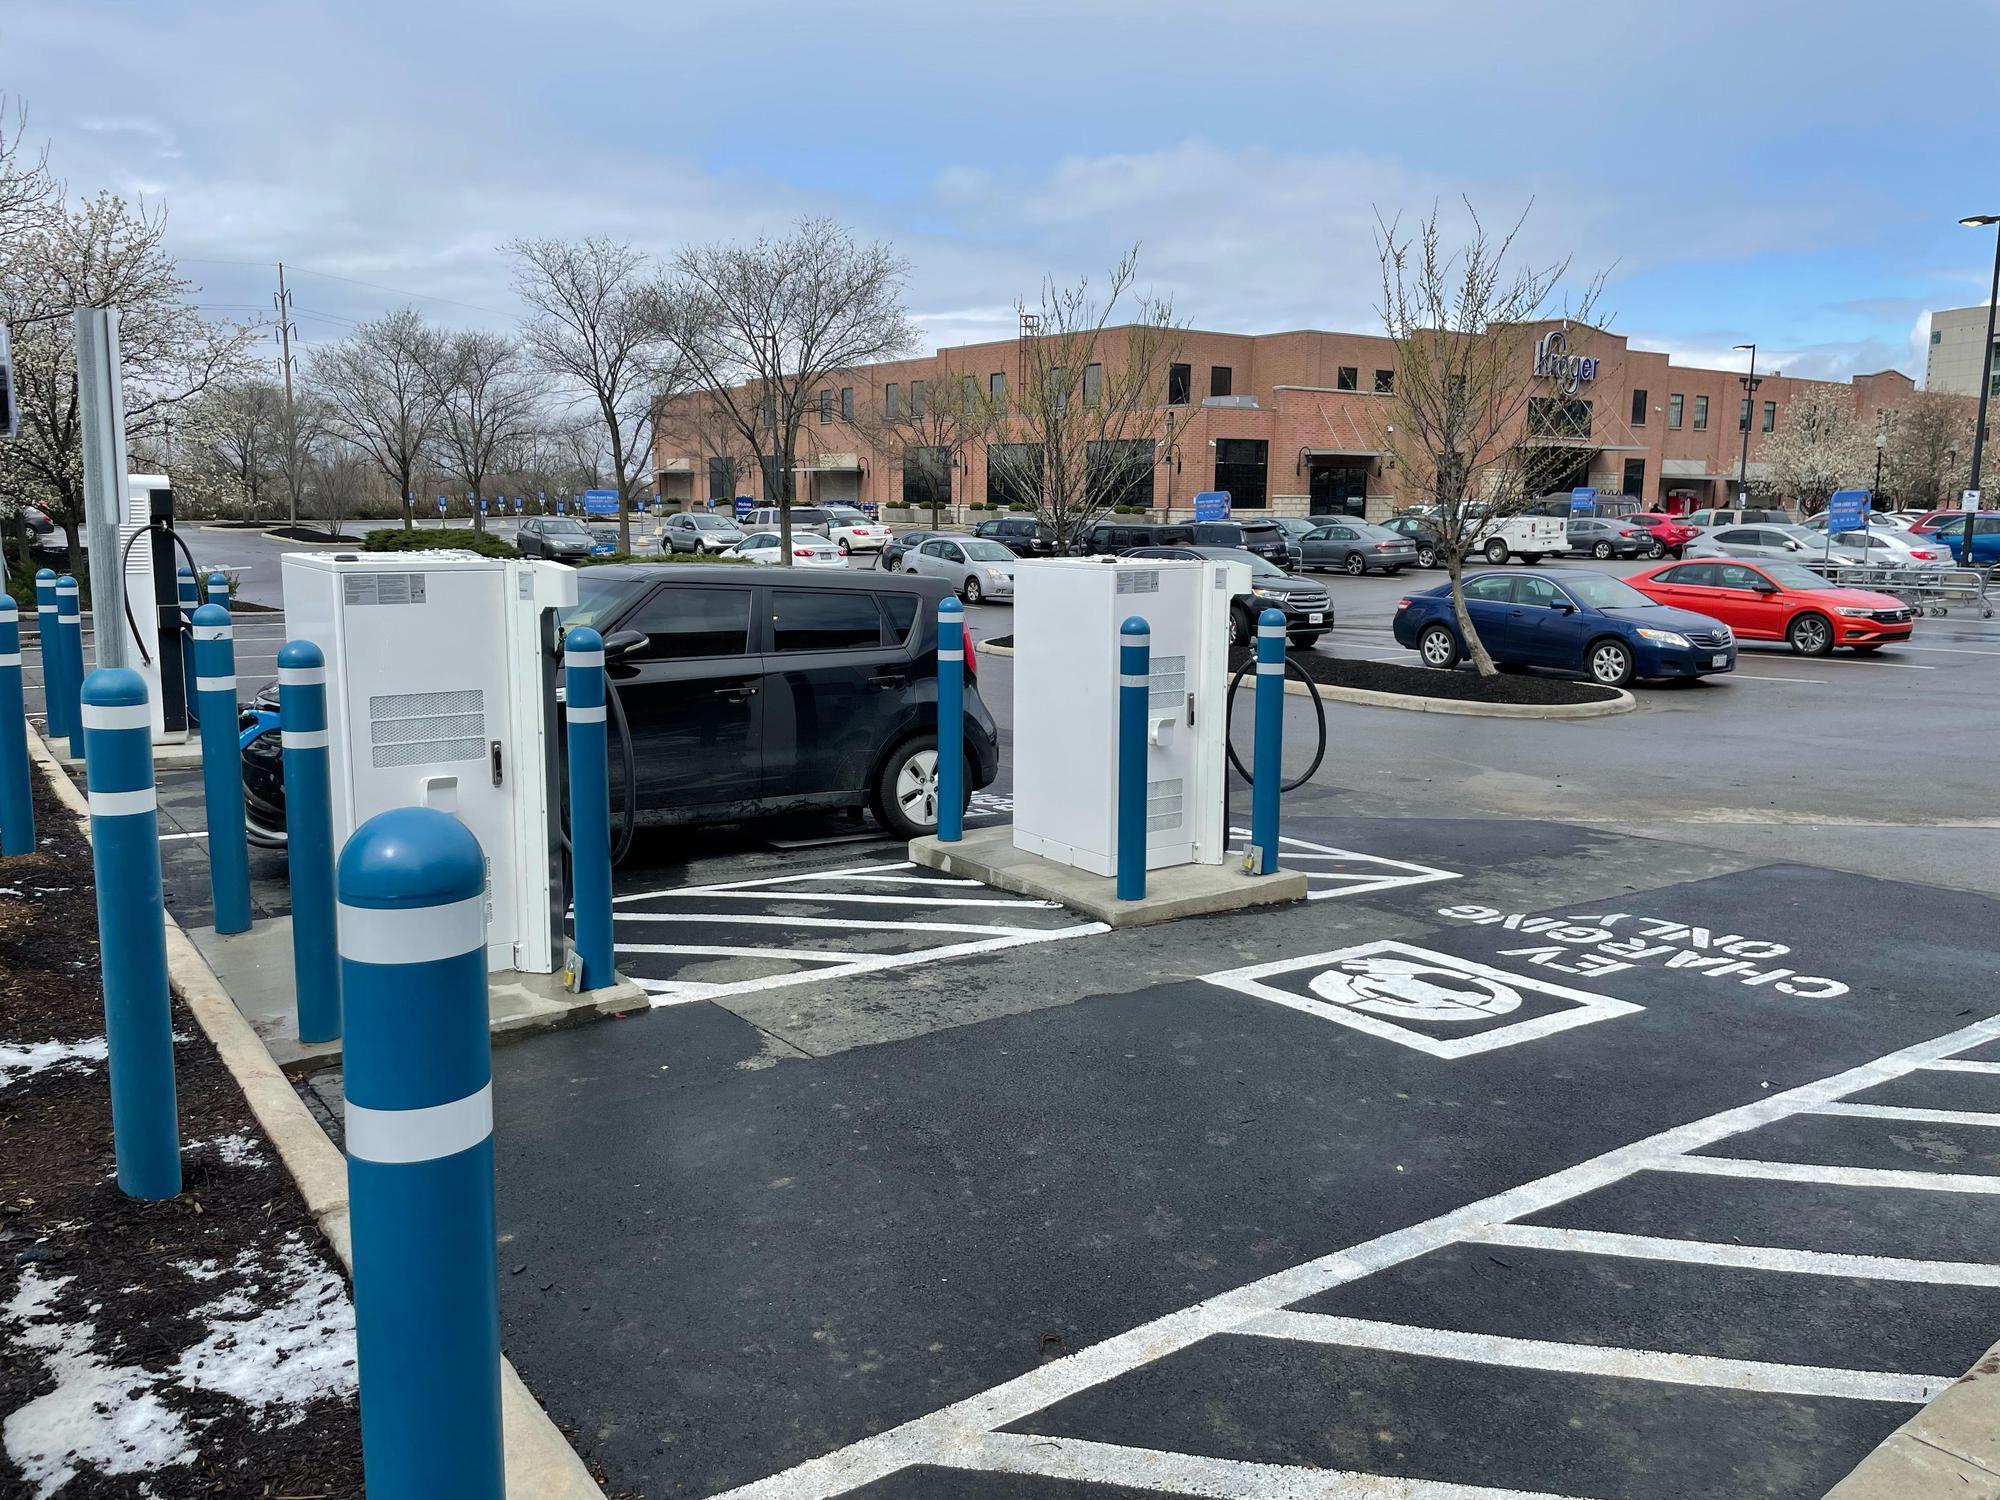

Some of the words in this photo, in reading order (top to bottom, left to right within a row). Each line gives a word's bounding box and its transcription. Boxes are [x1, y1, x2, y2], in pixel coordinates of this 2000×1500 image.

[1534, 331, 1600, 395] Kroger
[1437, 905, 1850, 999] CHARGING
[1496, 946, 1645, 977] EV
[1567, 912, 1792, 959] ONLY
